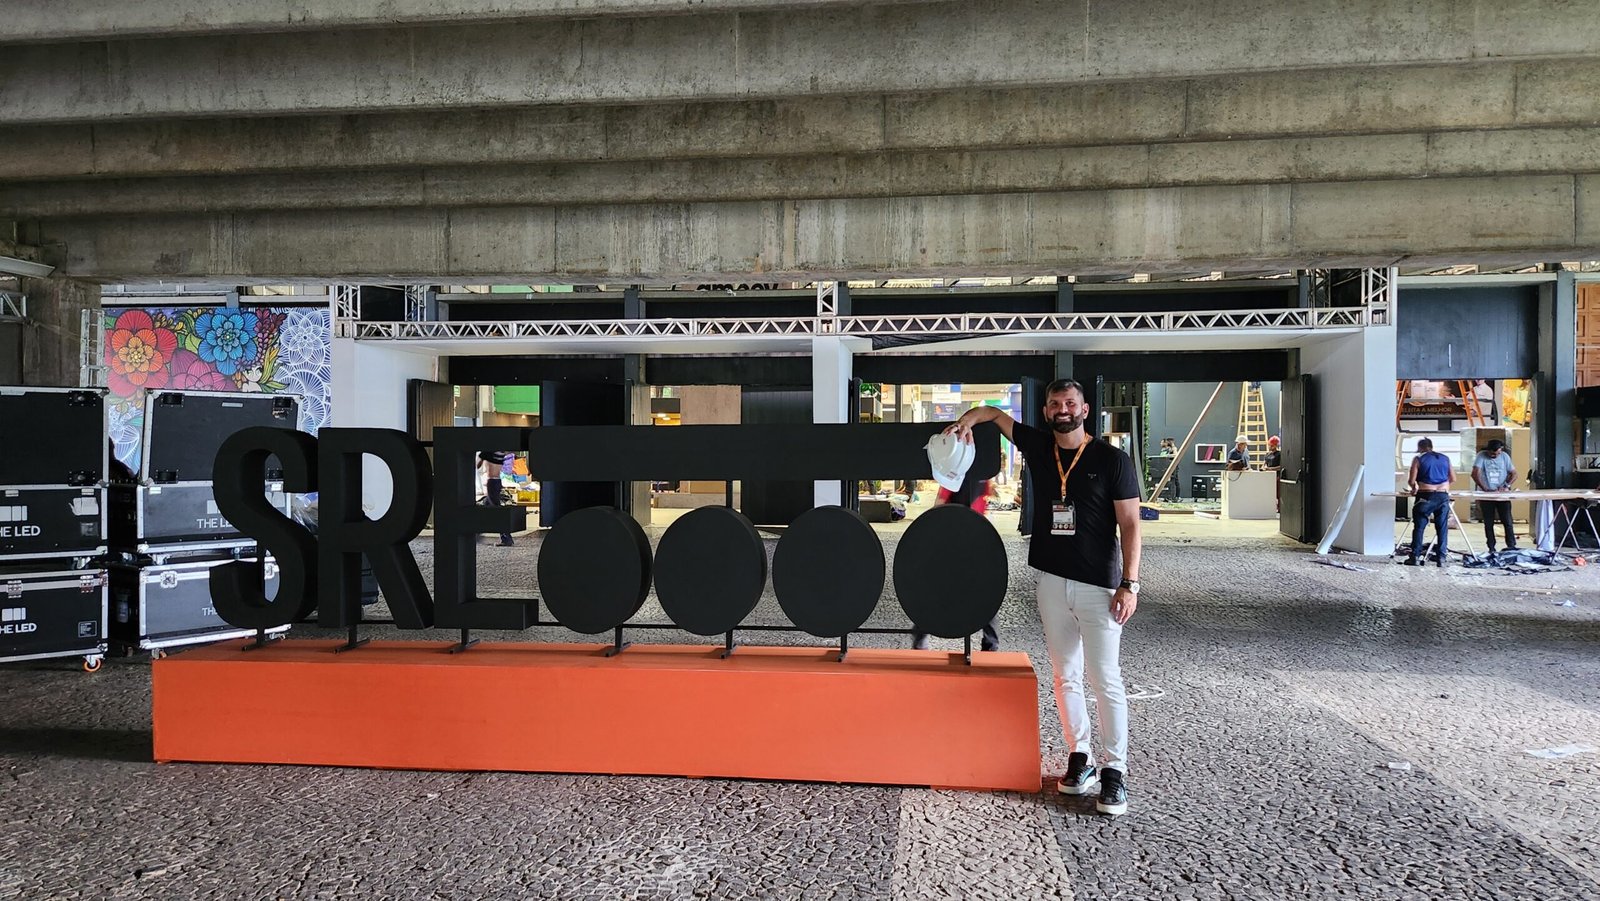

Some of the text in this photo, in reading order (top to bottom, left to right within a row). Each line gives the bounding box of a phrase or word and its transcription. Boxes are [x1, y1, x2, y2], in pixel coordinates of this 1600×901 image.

[196, 517, 218, 529] THE
[209, 425, 539, 632] SRE
[14, 525, 41, 537] LED
[15, 622, 37, 634] LED
